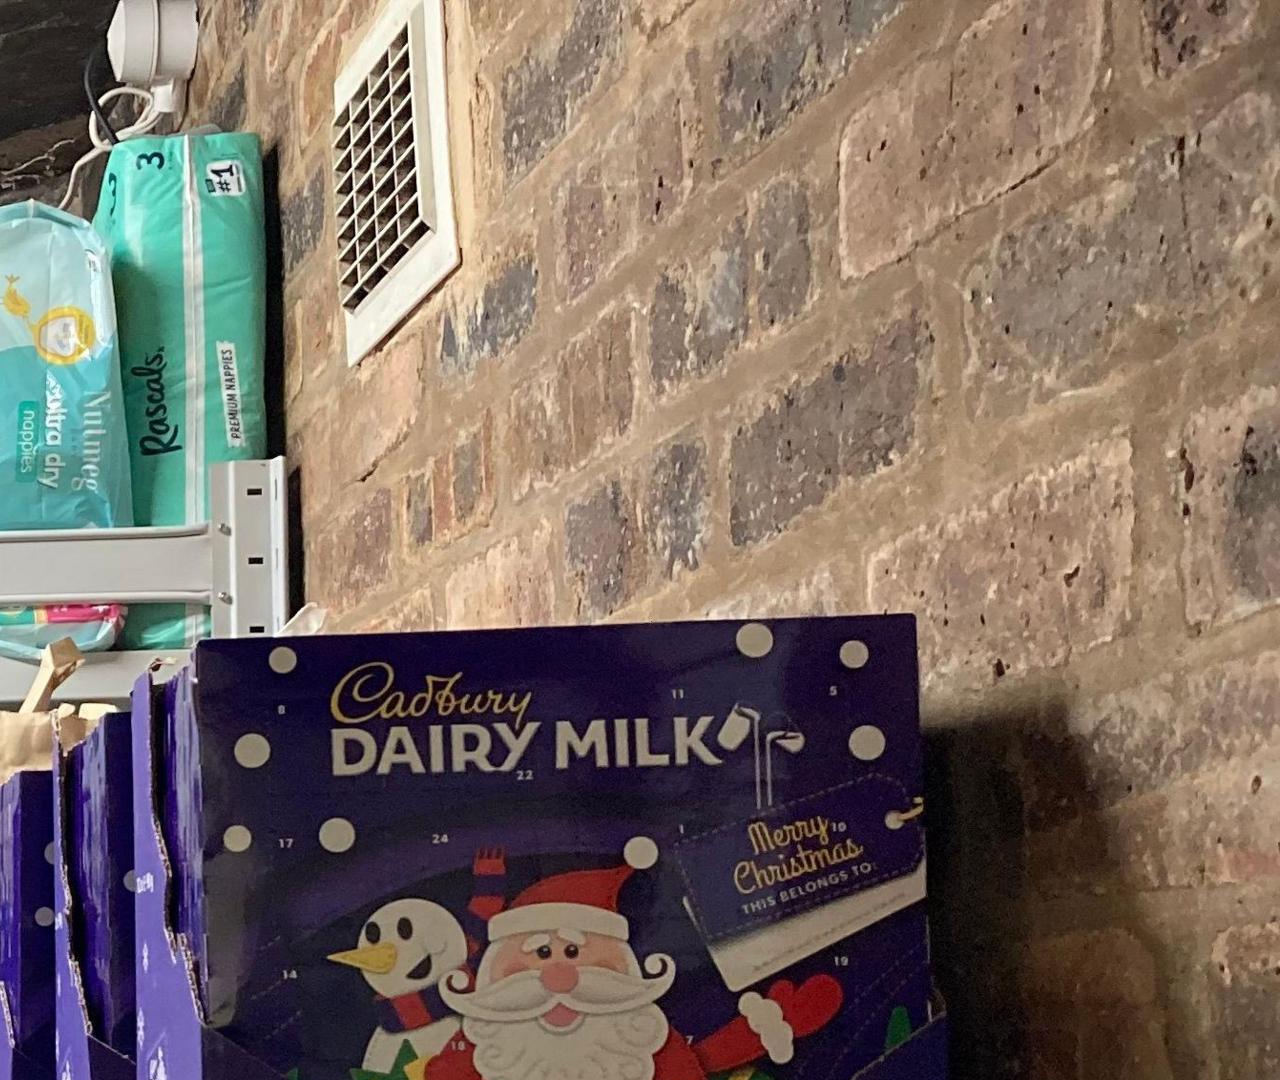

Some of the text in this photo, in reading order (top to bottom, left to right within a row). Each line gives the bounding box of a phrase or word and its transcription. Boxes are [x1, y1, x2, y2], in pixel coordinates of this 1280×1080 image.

[222, 349, 241, 439] PREMIUM NAPPIES
[19, 409, 35, 473] nappies
[72, 390, 111, 493] Nutmeg
[38, 453, 66, 489] dry
[330, 661, 533, 729] Cadbury
[331, 714, 724, 777] DAIRY MILK
[516, 769, 535, 781] 22
[278, 837, 294, 850] 17
[432, 833, 450, 845] 24
[748, 816, 832, 855] Merry
[734, 838, 865, 895] Christmas
[741, 896, 777, 915] THIS
[779, 870, 849, 903] BELONGS
[281, 968, 298, 981] 14
